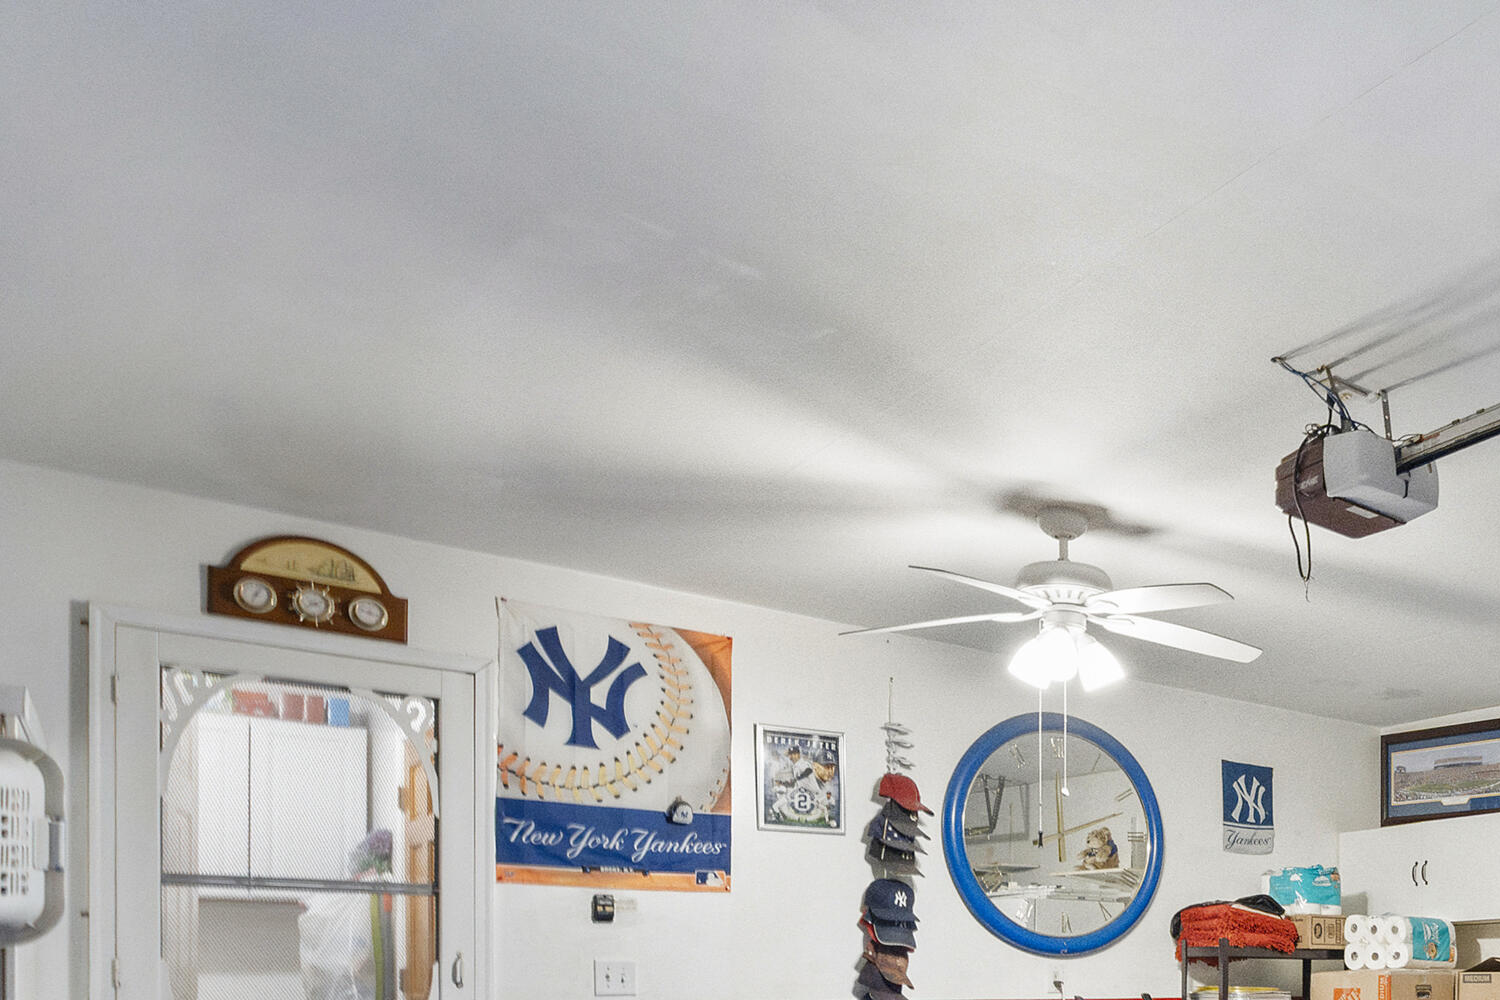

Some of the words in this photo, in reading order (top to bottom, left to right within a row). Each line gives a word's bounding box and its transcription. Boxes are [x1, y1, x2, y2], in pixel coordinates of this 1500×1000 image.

[516, 625, 648, 750] NY
[1231, 774, 1266, 824] NY
[503, 817, 564, 846] New
[566, 823, 629, 860] York
[630, 828, 723, 863] Yankees
[1225, 829, 1271, 850] Yankees
[894, 889, 908, 909] NY
